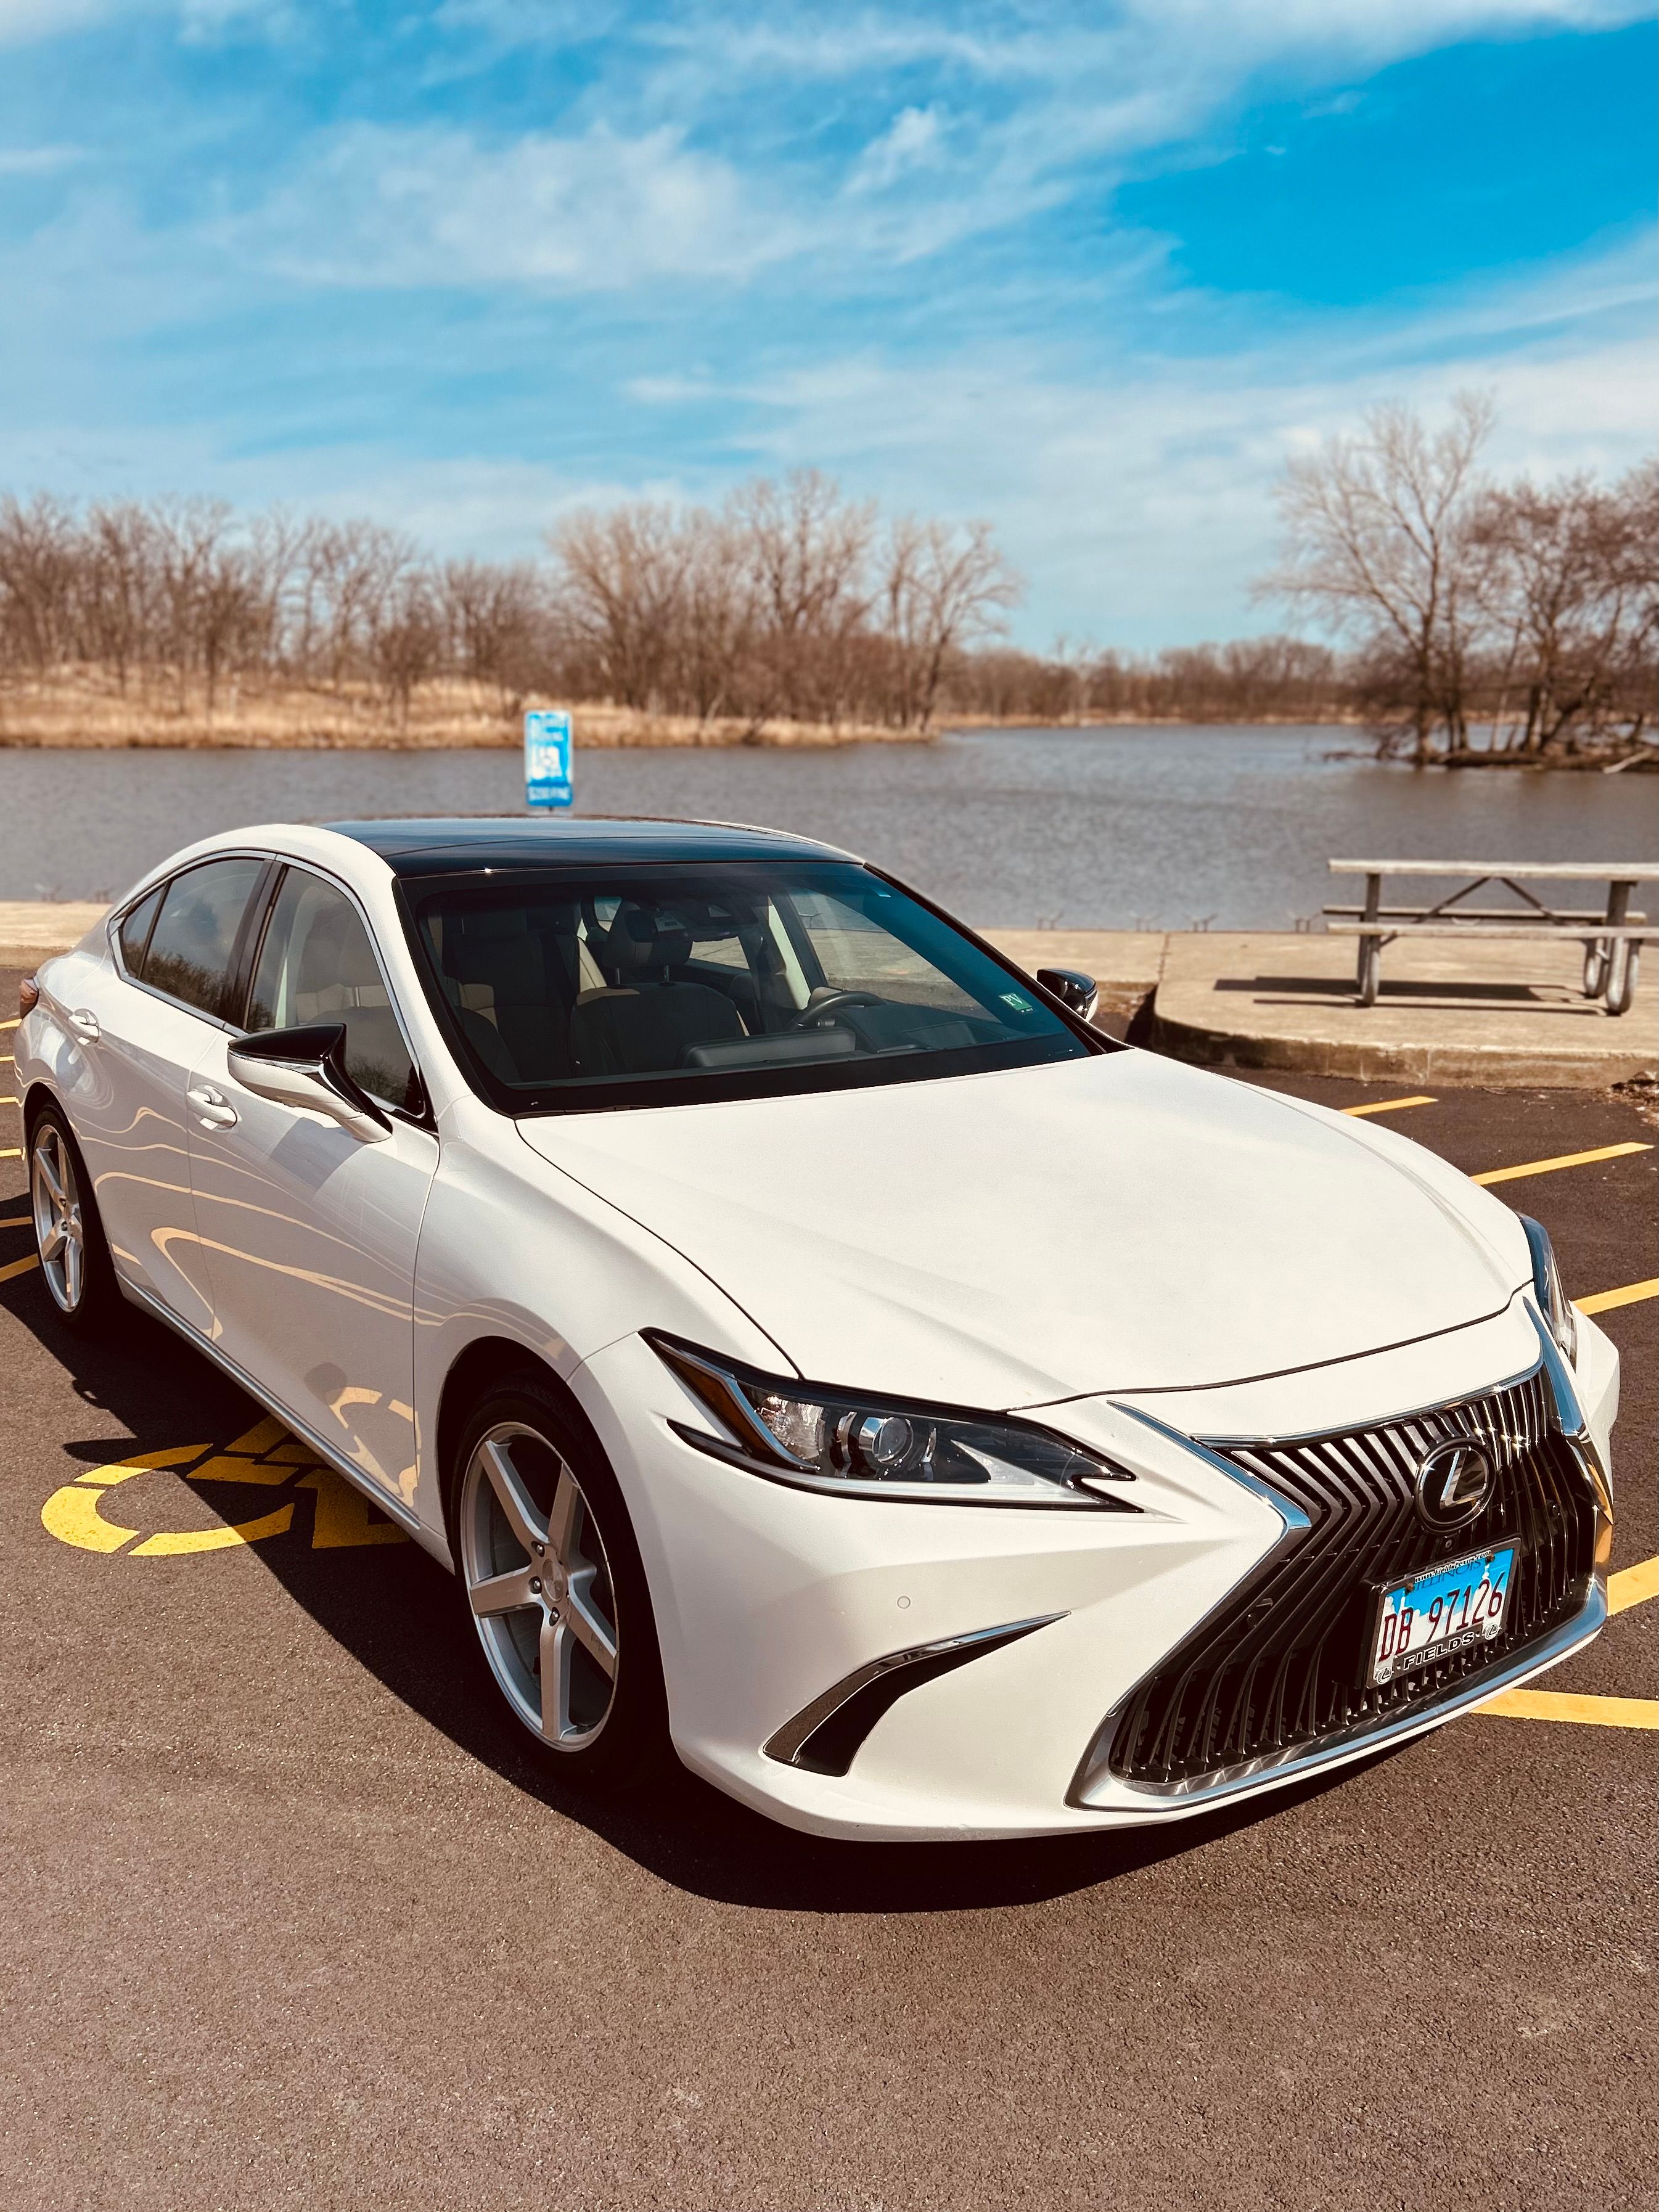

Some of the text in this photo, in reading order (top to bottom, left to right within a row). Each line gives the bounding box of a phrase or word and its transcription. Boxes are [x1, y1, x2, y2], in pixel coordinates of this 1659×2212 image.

[1379, 1571, 1505, 1661] DB 97126
[1403, 1631, 1474, 1671] FIELDS
